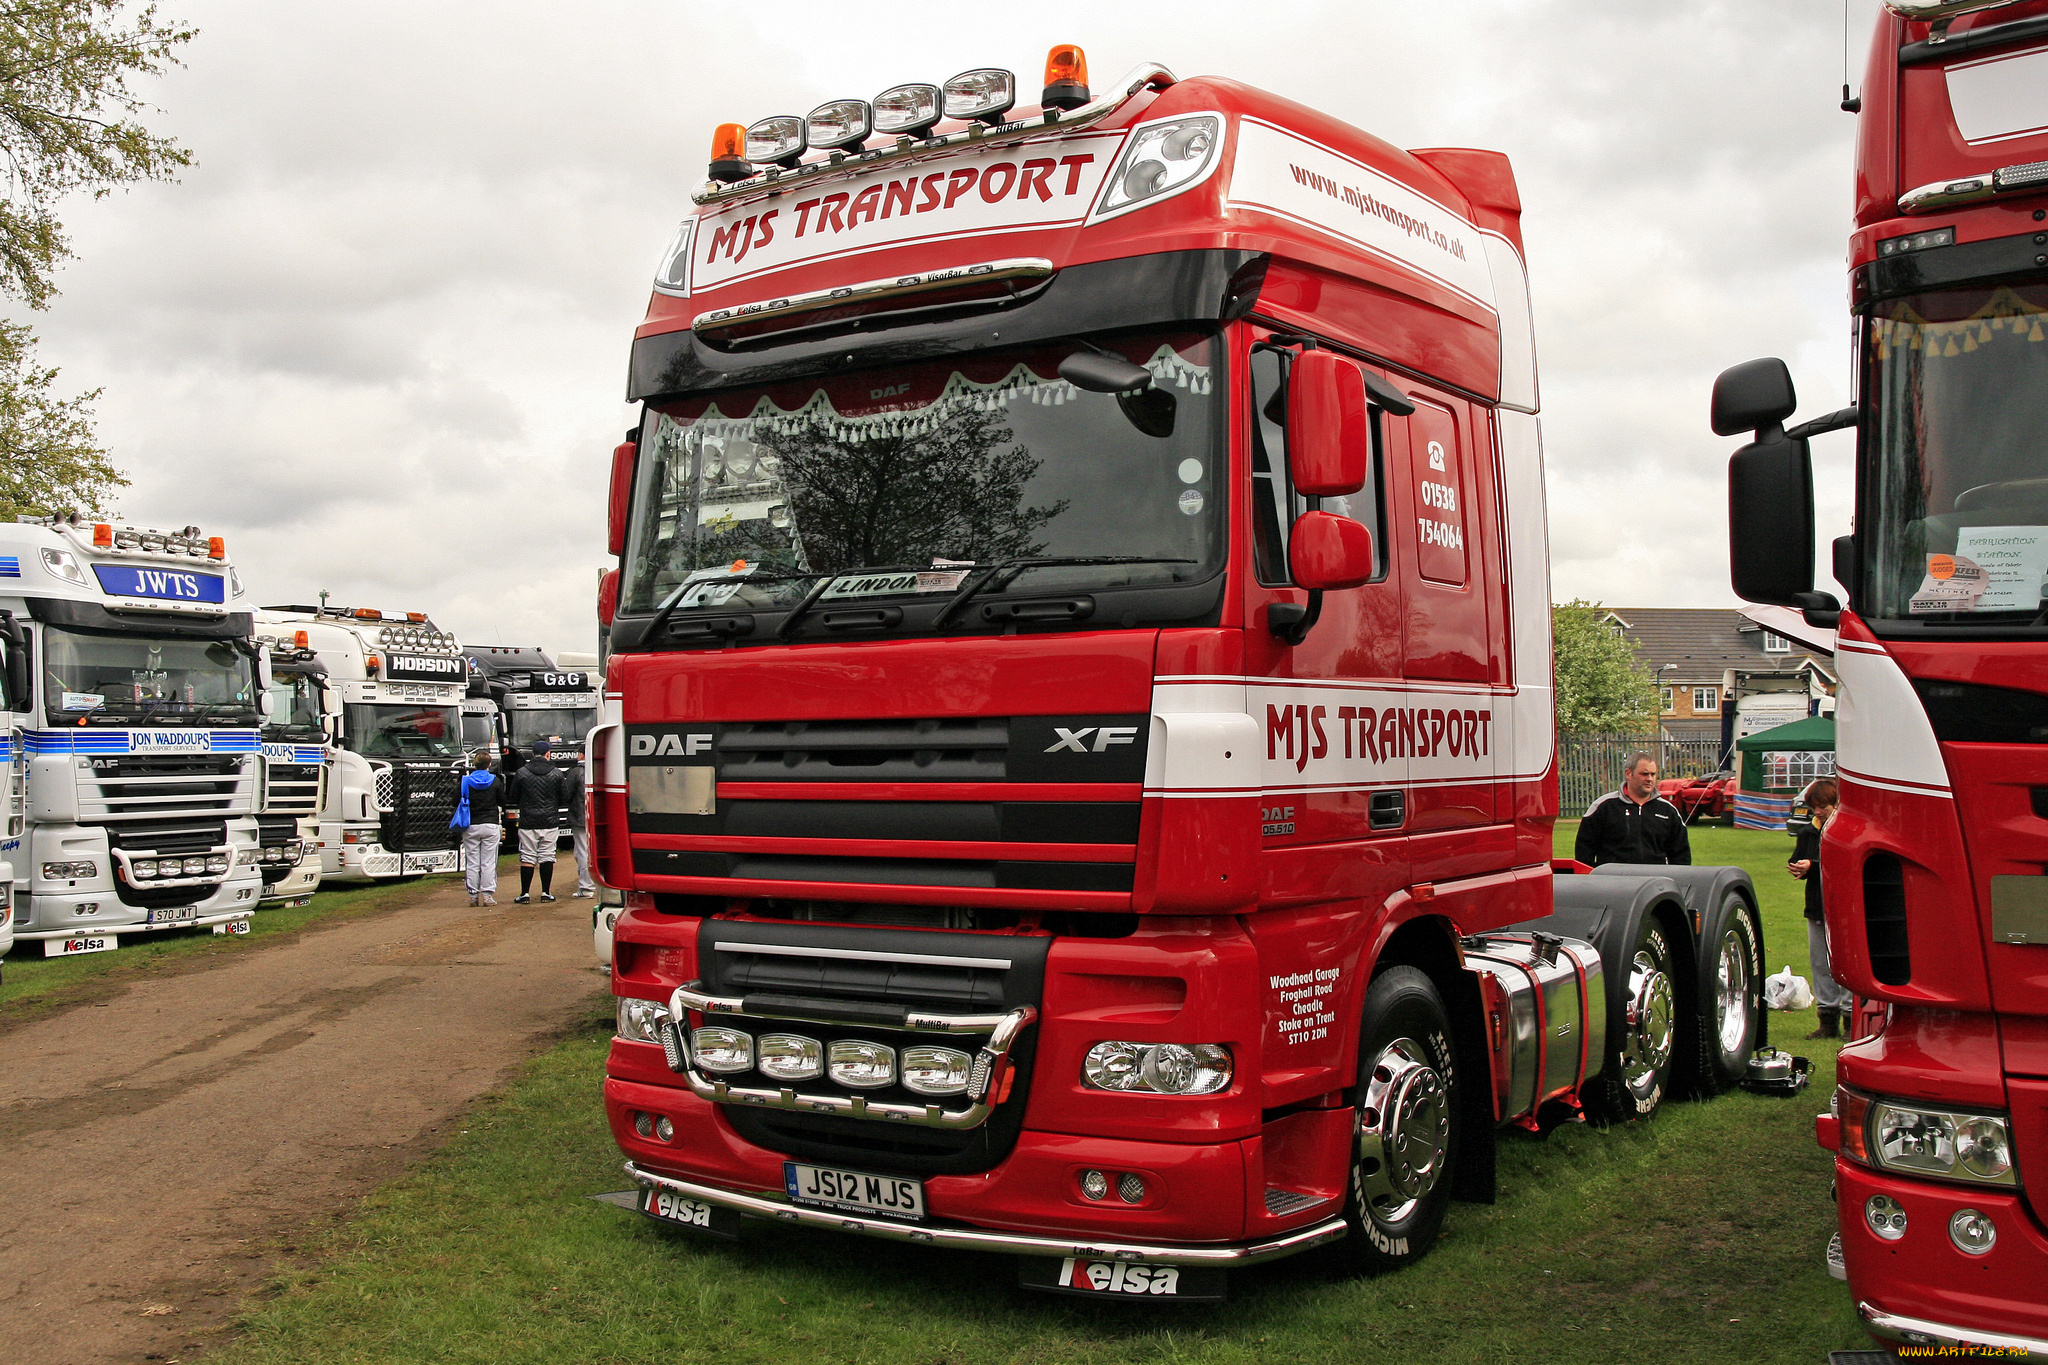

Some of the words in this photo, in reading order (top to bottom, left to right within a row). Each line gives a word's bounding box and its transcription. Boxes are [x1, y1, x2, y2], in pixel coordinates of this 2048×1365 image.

[707, 208, 779, 264] MJS
[794, 153, 1095, 237] TRANSPORT
[1289, 163, 1466, 262] www.mjstransport.co.uk
[927, 268, 962, 283] VisorBar
[870, 383, 911, 399] DAF
[1421, 480, 1456, 511] 01538
[1418, 518, 1463, 550] 754064
[135, 570, 199, 597] JWTS
[393, 656, 460, 673] HOBSON
[544, 673, 580, 686] G&G
[131, 733, 152, 751] JON
[154, 732, 210, 750] WADDOUPS
[630, 733, 713, 756] DAF
[1043, 727, 1139, 752] XF
[1266, 704, 1328, 773] MJS
[1338, 705, 1491, 764] TRANSPORT
[78, 759, 119, 769] DAF
[230, 757, 252, 766] XF
[301, 767, 318, 775] XF
[1262, 824, 1295, 834] 05.510
[157, 909, 174, 920] S70
[175, 907, 193, 918] JWT
[225, 922, 248, 934] Kelsa
[63, 938, 105, 952] Kelsa
[1270, 969, 1313, 989] Woodhead
[1315, 967, 1340, 981] Garage
[1280, 986, 1313, 1003] Froghall
[1314, 982, 1333, 996] Road
[707, 1000, 733, 1011] Kelsa
[1292, 999, 1323, 1015] Cheadle
[915, 1019, 950, 1030] MultiBar
[1278, 1018, 1302, 1032] Stoke
[1304, 1017, 1314, 1028] on
[1316, 1010, 1335, 1025] Trent
[1288, 1031, 1309, 1045] ST10
[1312, 1027, 1327, 1040] 2DN
[1635, 1084, 1662, 1113] MICHE
[807, 1169, 860, 1201] JS12
[865, 1177, 915, 1209] MJS
[645, 1190, 711, 1227] Kelsa
[1353, 1164, 1409, 1256] MICHELIN
[1073, 1246, 1105, 1256] LoBar
[1058, 1258, 1179, 1294] Kelsa
